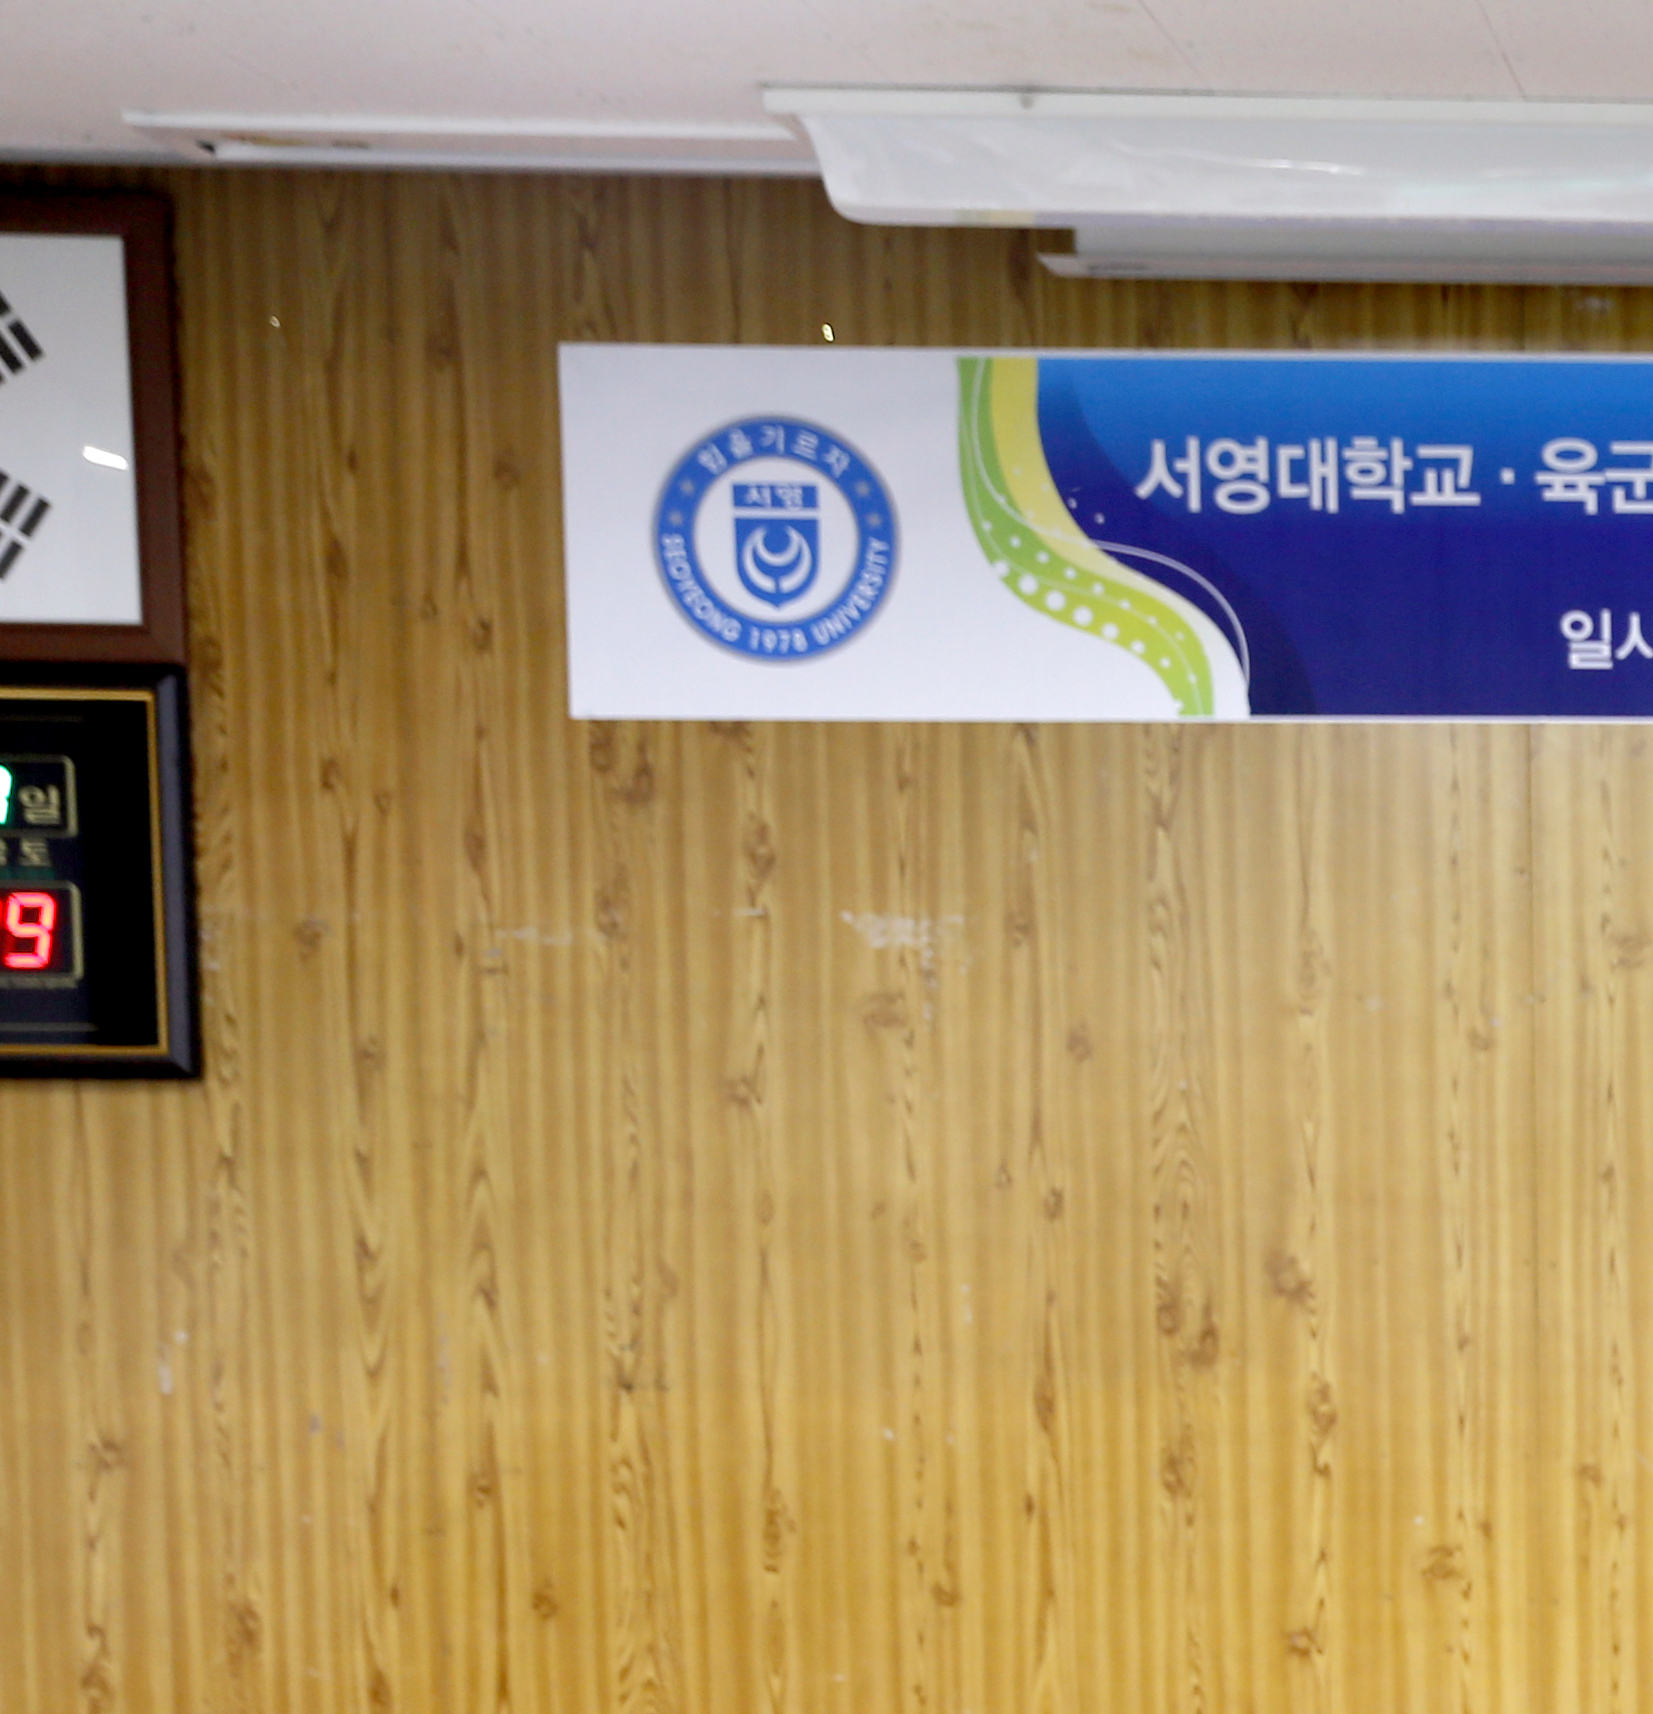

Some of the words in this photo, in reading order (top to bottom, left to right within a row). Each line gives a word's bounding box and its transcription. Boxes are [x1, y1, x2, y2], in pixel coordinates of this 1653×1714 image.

[744, 486, 804, 509] 서영
[661, 532, 743, 642] SEOYEONG
[748, 625, 809, 654] 1978
[811, 536, 891, 646] UNIVERSITY
